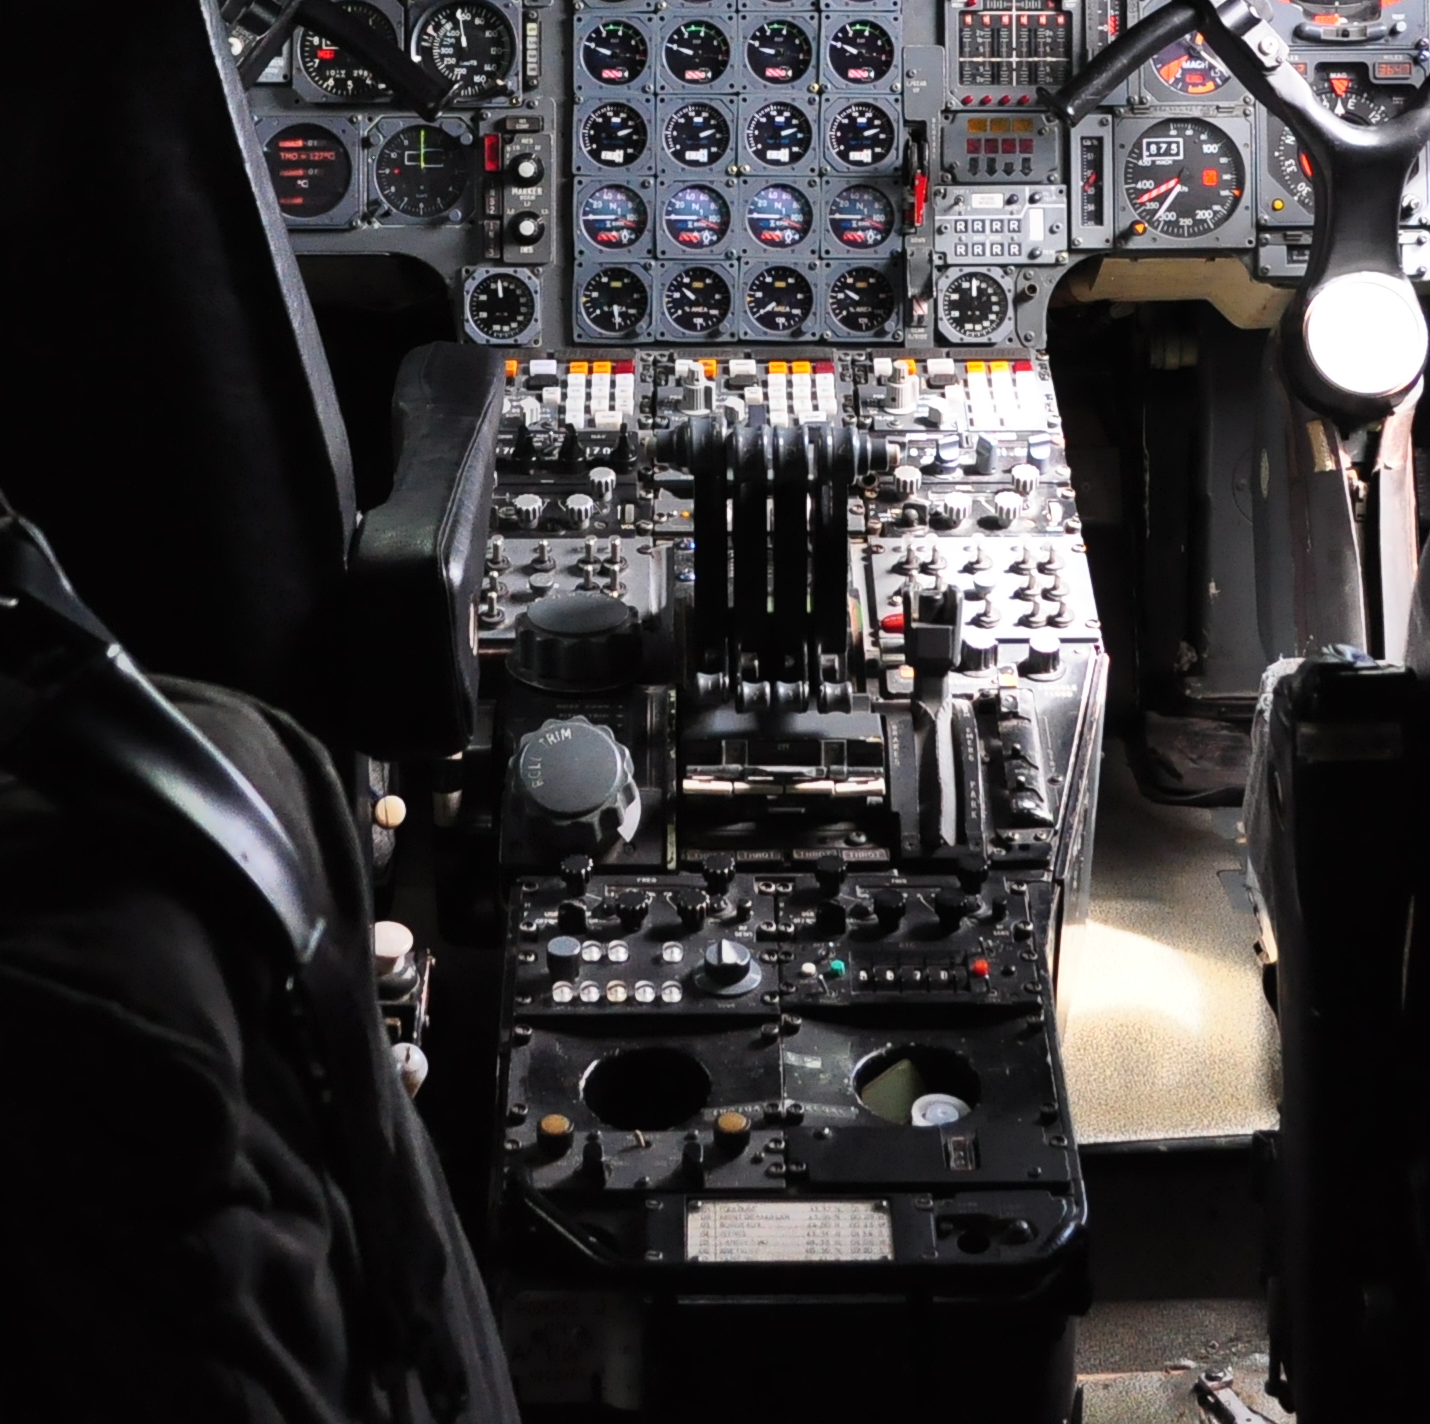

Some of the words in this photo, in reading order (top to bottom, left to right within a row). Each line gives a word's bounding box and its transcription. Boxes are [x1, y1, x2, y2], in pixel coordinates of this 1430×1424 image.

[1202, 144, 1218, 153] 100
[1136, 180, 1154, 189] 400
[1195, 210, 1213, 219] 200
[957, 222, 966, 231] R
[973, 222, 982, 231] R
[992, 222, 1001, 231] R
[1010, 221, 1019, 231] R
[957, 246, 966, 255] R
[973, 246, 982, 255] R
[992, 246, 1002, 255] R
[1010, 246, 1020, 255] R
[538, 728, 572, 748] TRIM
